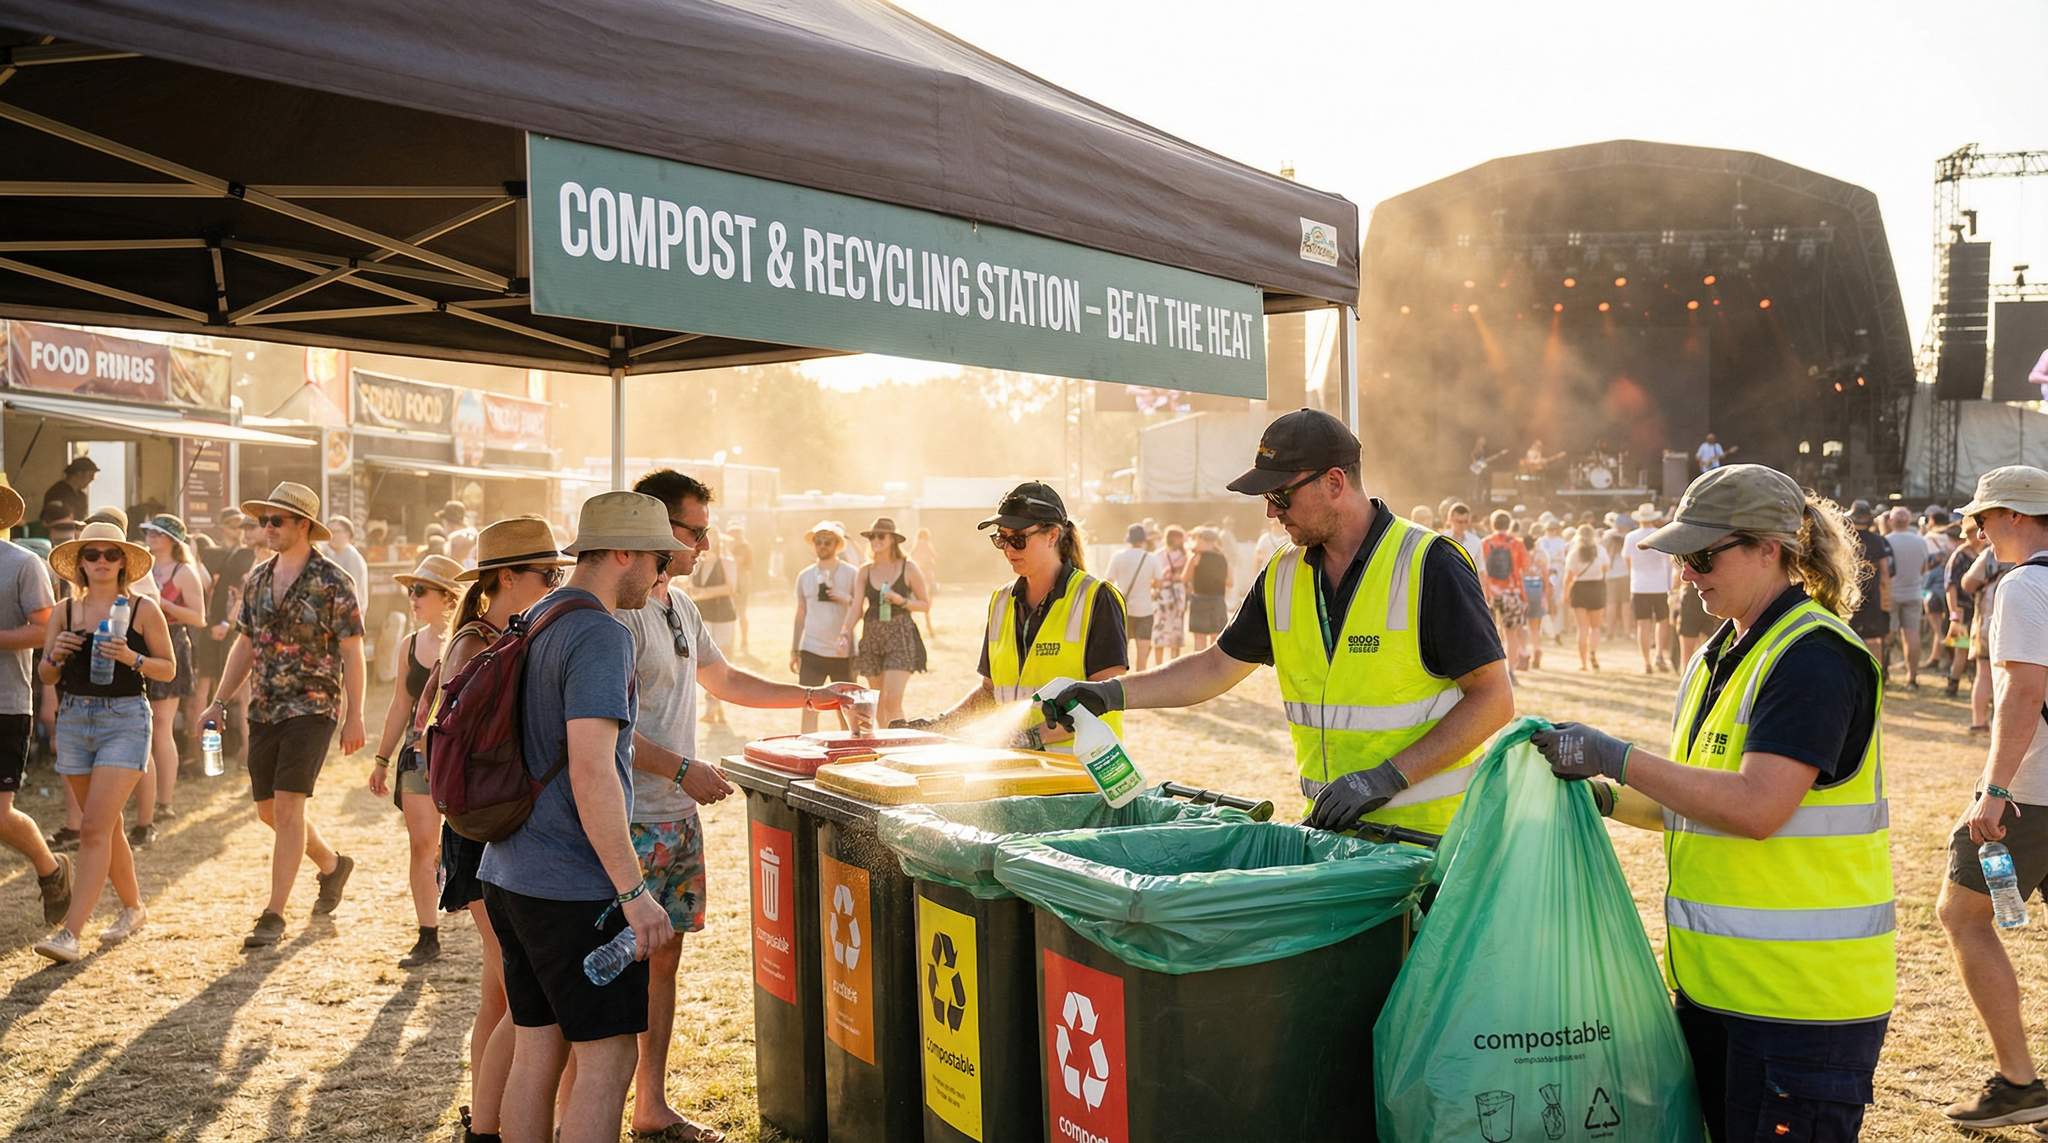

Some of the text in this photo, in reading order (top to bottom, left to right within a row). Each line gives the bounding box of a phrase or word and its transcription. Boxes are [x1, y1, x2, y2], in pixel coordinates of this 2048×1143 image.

[560, 182, 756, 283] COMPOST
[767, 221, 796, 289] &
[804, 227, 970, 317] RECYCLING
[977, 262, 1081, 334] STATION
[1107, 287, 1159, 345] BEAT
[1164, 298, 1203, 352] THE
[1207, 305, 1252, 360] HEAT
[31, 341, 90, 376] FOOD
[1474, 1019, 1611, 1052] compostable
